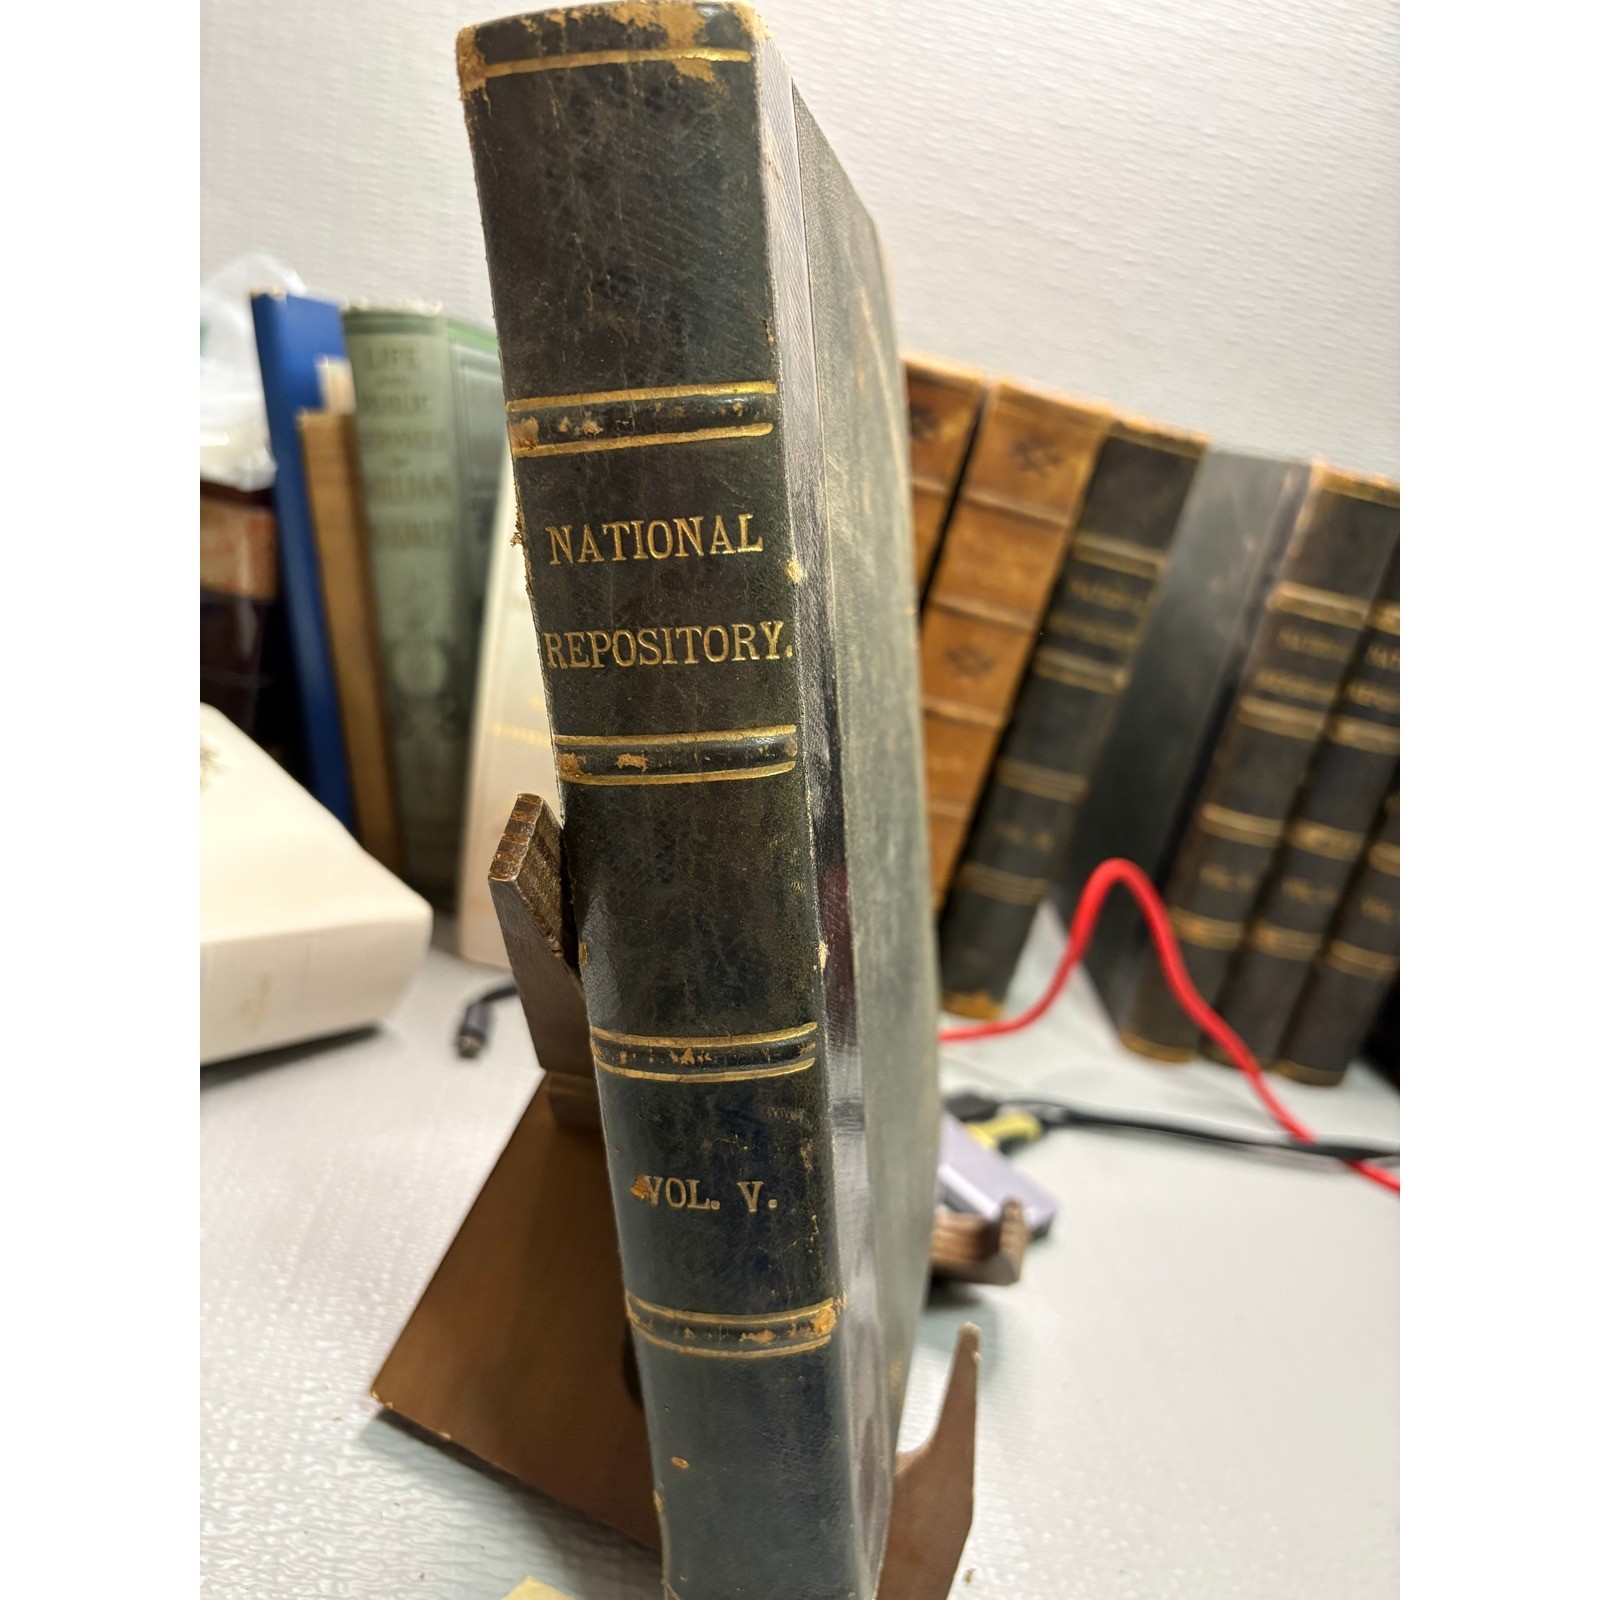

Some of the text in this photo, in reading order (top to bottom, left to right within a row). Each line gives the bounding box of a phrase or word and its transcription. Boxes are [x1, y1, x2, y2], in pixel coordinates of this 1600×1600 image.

[545, 513, 764, 565] NATIONAL
[542, 620, 794, 669] REPOSITORY.
[643, 1175, 778, 1212] VOL. V.
